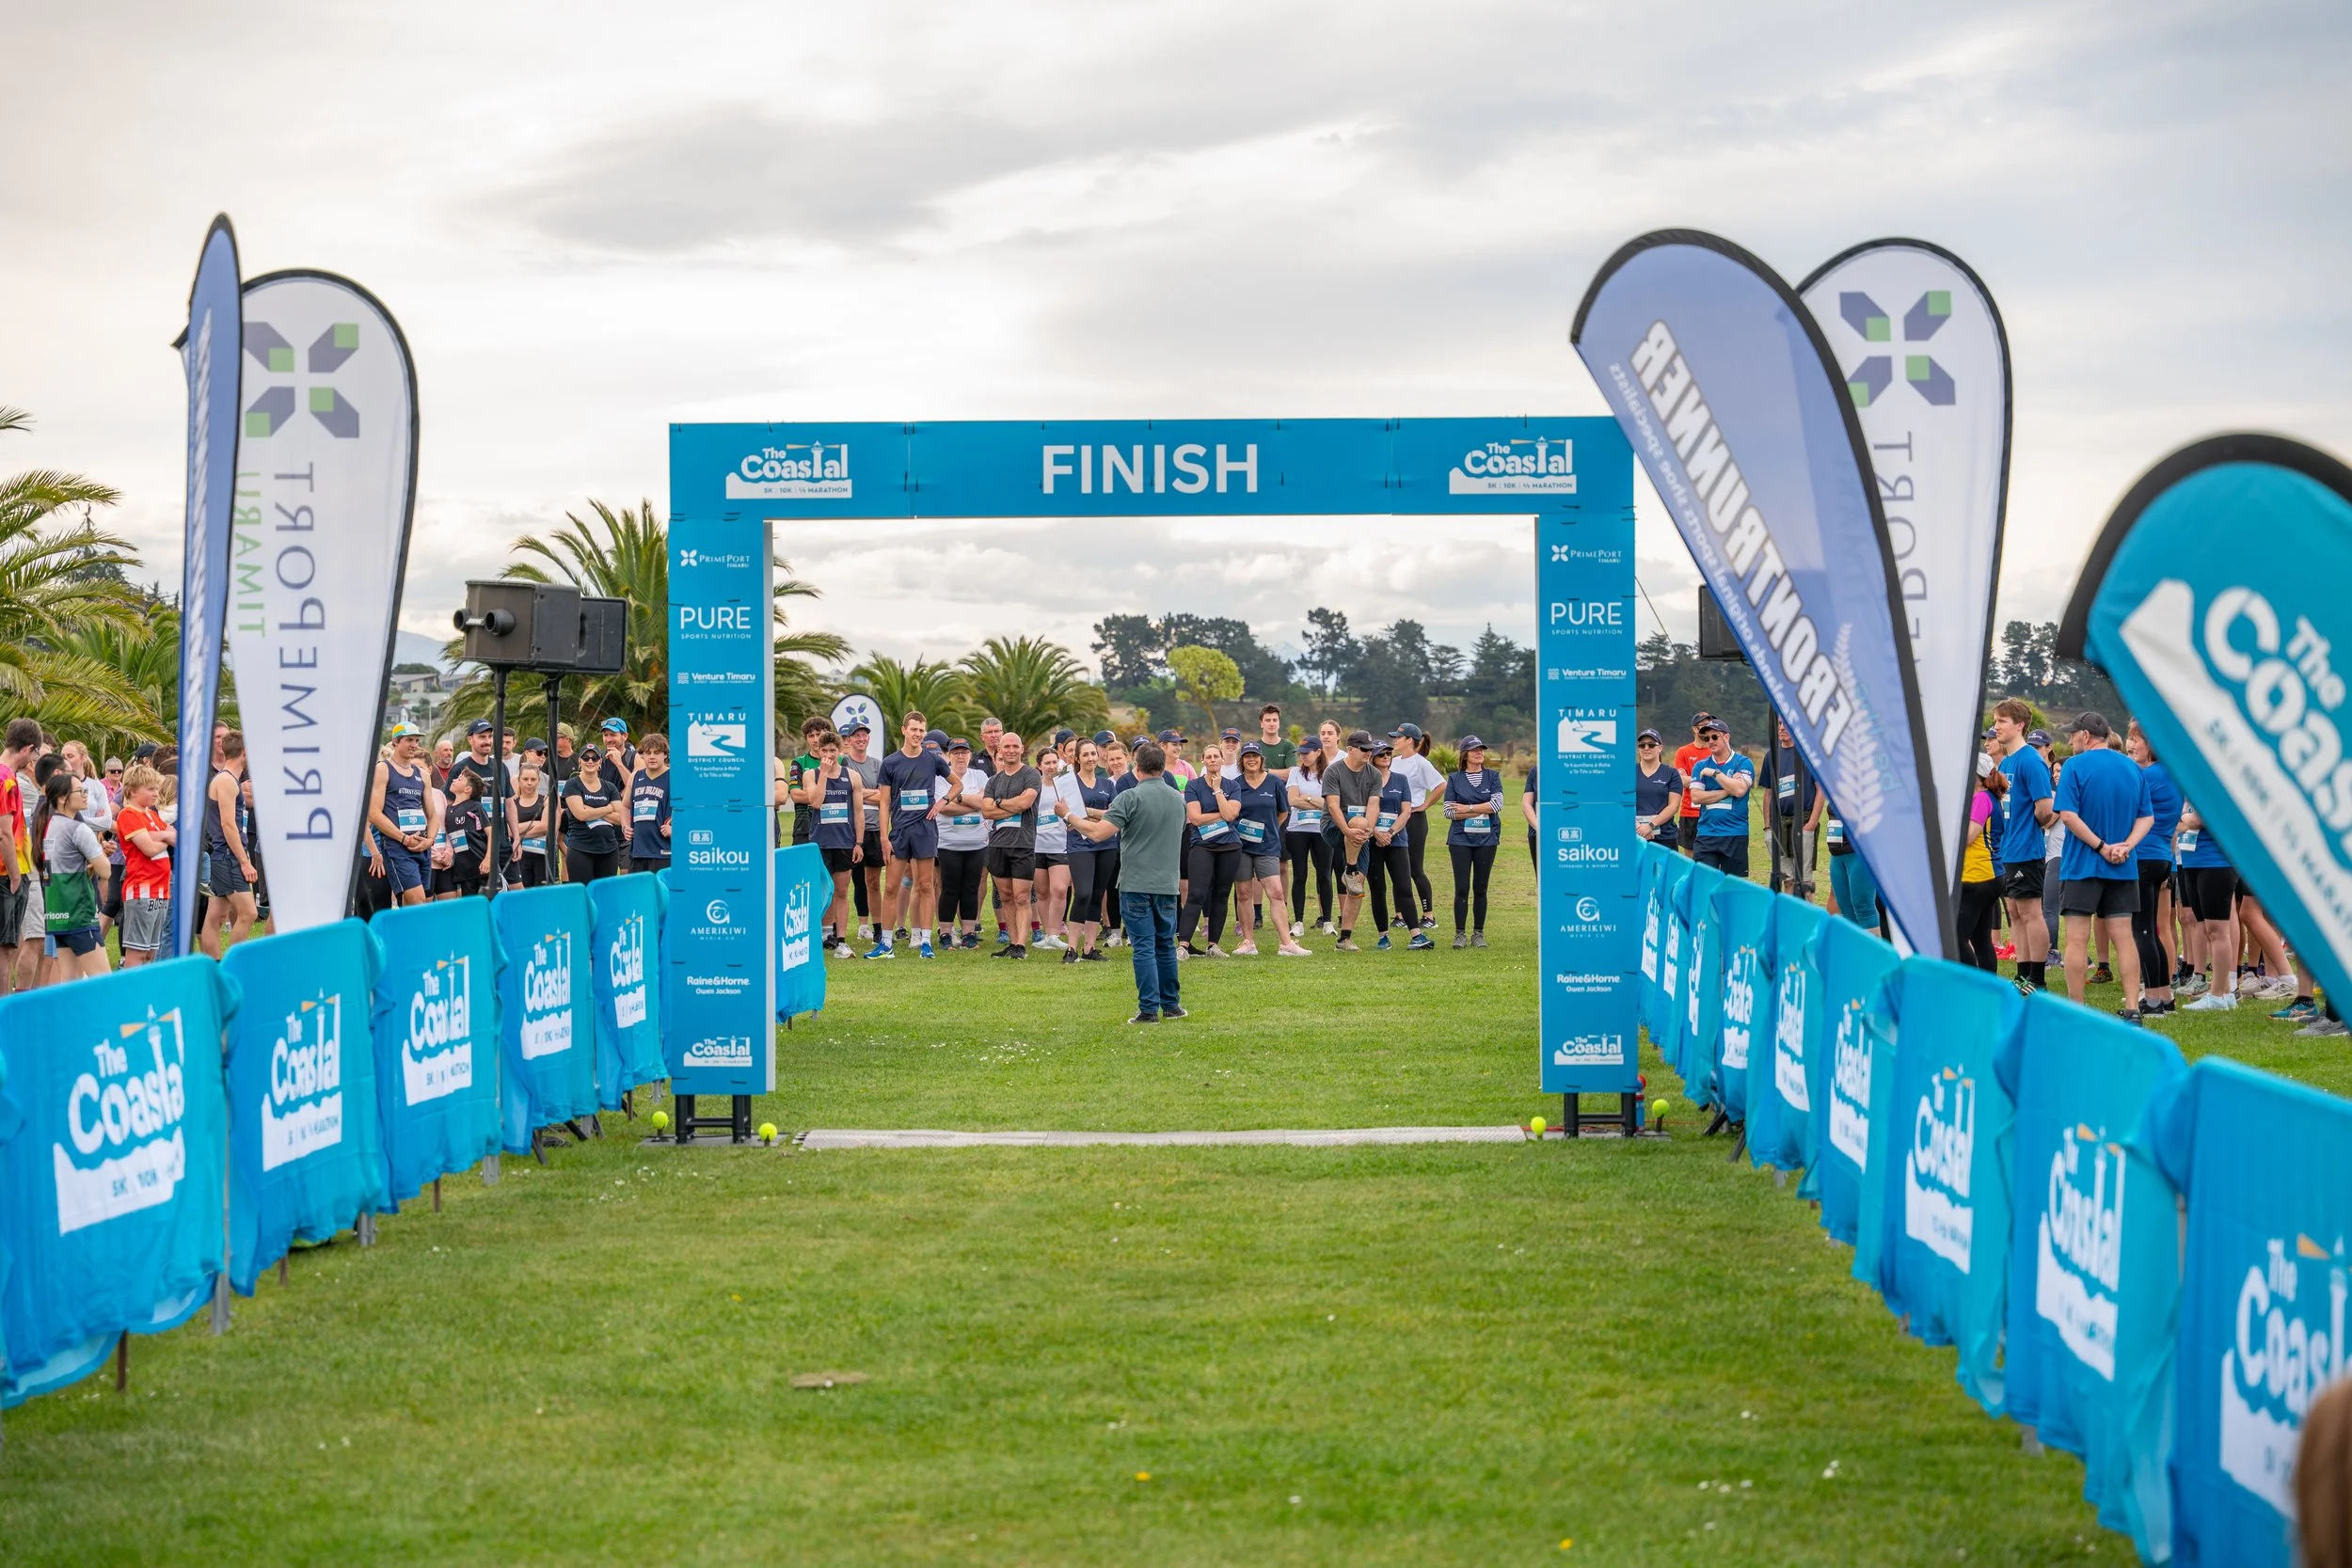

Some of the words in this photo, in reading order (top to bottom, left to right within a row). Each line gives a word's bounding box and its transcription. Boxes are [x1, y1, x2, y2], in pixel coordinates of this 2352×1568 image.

[762, 447, 787, 459] The
[1465, 436, 1573, 474] Coastal
[1486, 442, 1511, 455] The
[740, 441, 849, 480] Coastal
[1043, 444, 1257, 495] FINISH
[680, 607, 751, 630] PURE
[1550, 602, 1622, 626] PURE
[1562, 669, 1596, 677] Venture
[1597, 668, 1627, 676] Timaru
[2286, 614, 2346, 711] The
[691, 673, 724, 681] Venture
[726, 672, 756, 681] Timaru
[688, 713, 747, 721] TIMARU
[1558, 709, 1617, 718] TIMARU
[634, 786, 645, 798] NEW
[645, 784, 664, 800] ORLEANS
[689, 847, 750, 863] saikou
[1558, 844, 1618, 862] saikou
[534, 942, 548, 967] The
[525, 927, 571, 1013] Coastal
[423, 969, 440, 998] The
[286, 1012, 303, 1043] The
[692, 1036, 751, 1057] Coastal
[1563, 1033, 1622, 1054] Coastal
[94, 1038, 128, 1078] The
[2267, 1238, 2297, 1302] The
